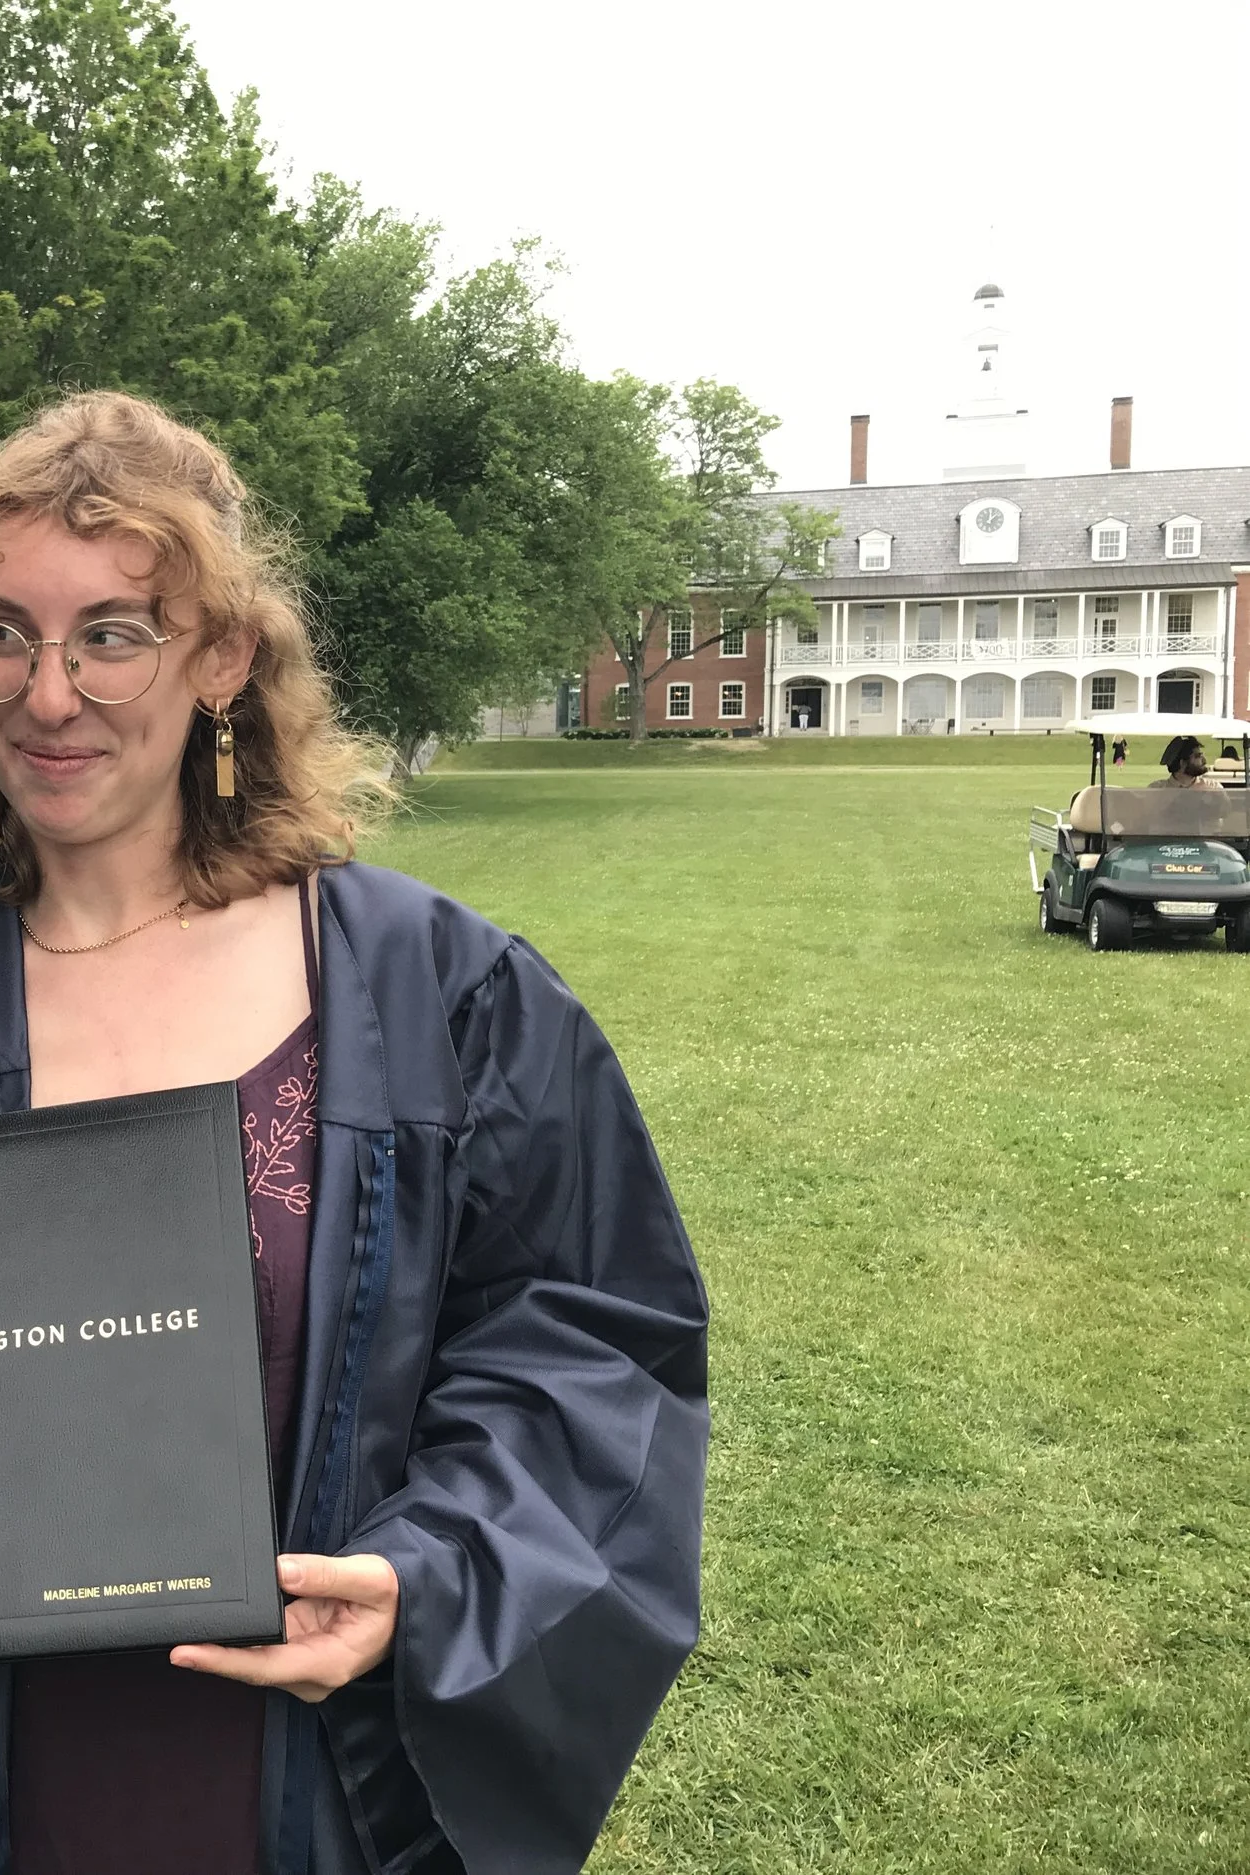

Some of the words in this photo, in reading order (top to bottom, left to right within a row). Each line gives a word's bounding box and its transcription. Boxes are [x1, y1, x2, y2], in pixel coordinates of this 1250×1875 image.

[1165, 864, 1185, 872] Club
[1187, 864, 1203, 872] Car
[79, 1308, 199, 1340] COLLEGE
[44, 1586, 100, 1601] MADELEINE
[104, 1581, 162, 1596] MARGARET
[167, 1577, 211, 1591] WATERS
